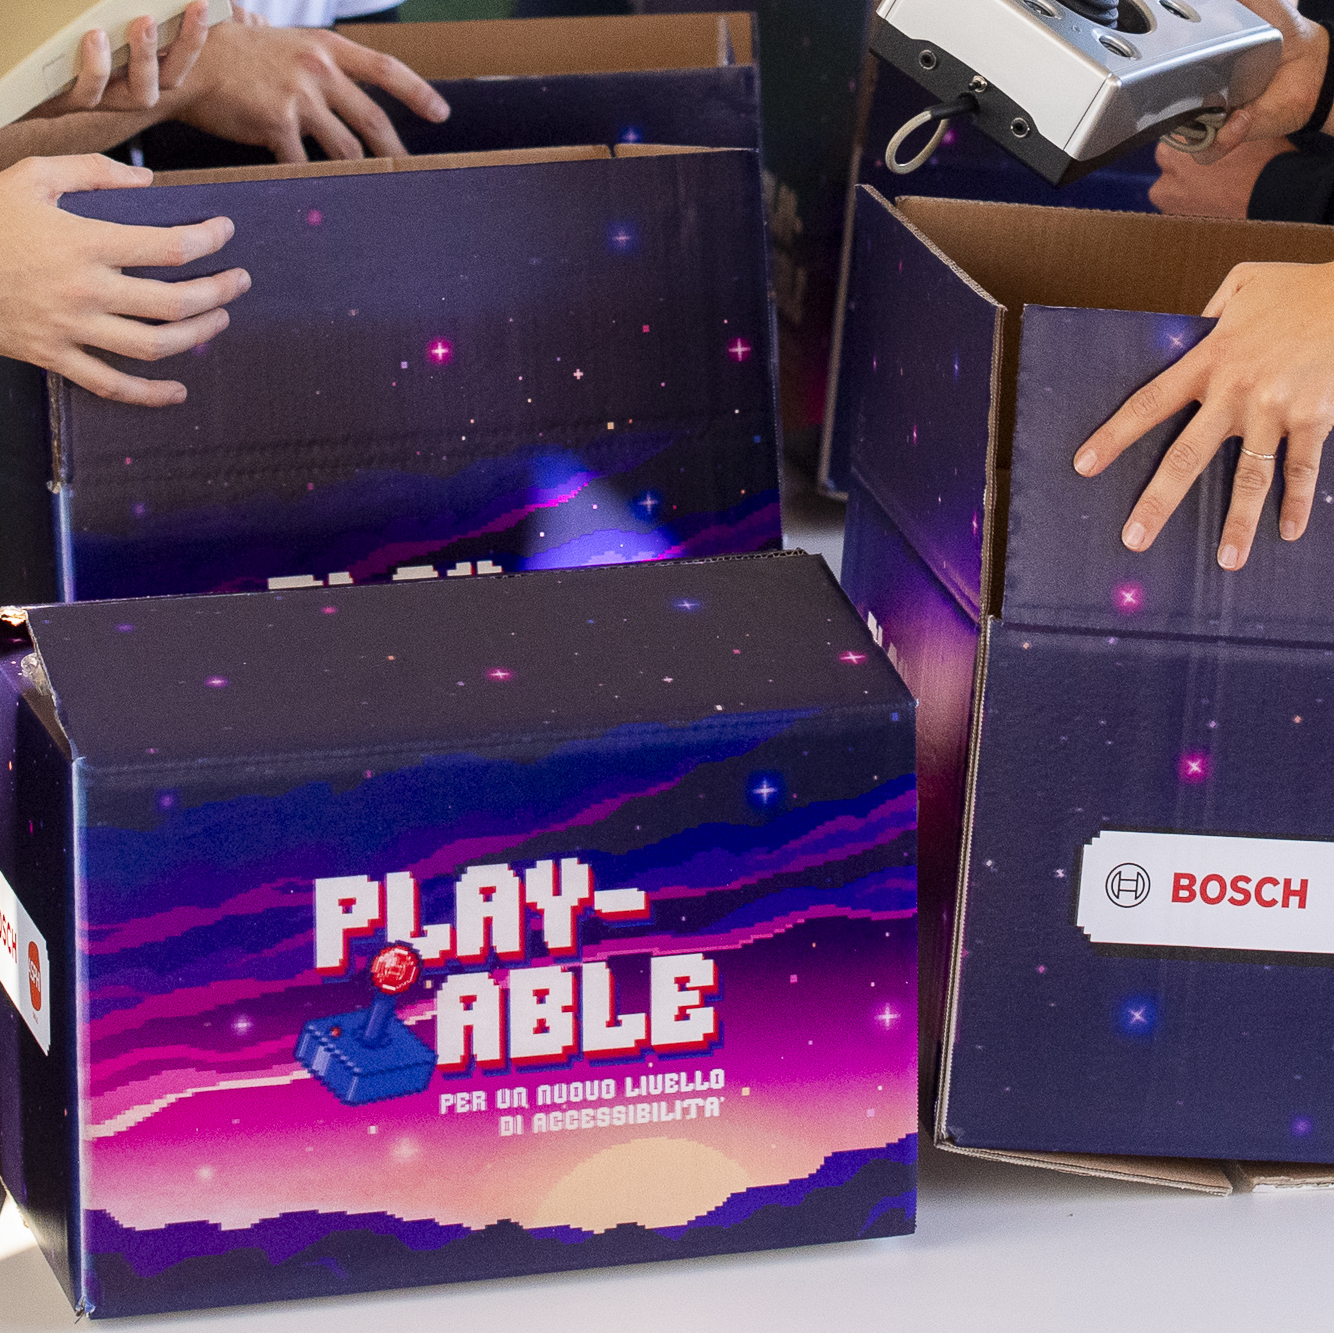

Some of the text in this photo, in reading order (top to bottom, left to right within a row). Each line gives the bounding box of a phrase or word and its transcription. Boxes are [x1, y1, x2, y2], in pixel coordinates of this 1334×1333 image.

[1171, 872, 1309, 909] BOSCH
[314, 857, 650, 974] PLAY-
[436, 953, 718, 1071] ABLE
[439, 1068, 725, 1114] PER UN NUOVO LIVELLO
[499, 1116, 523, 1137] DI
